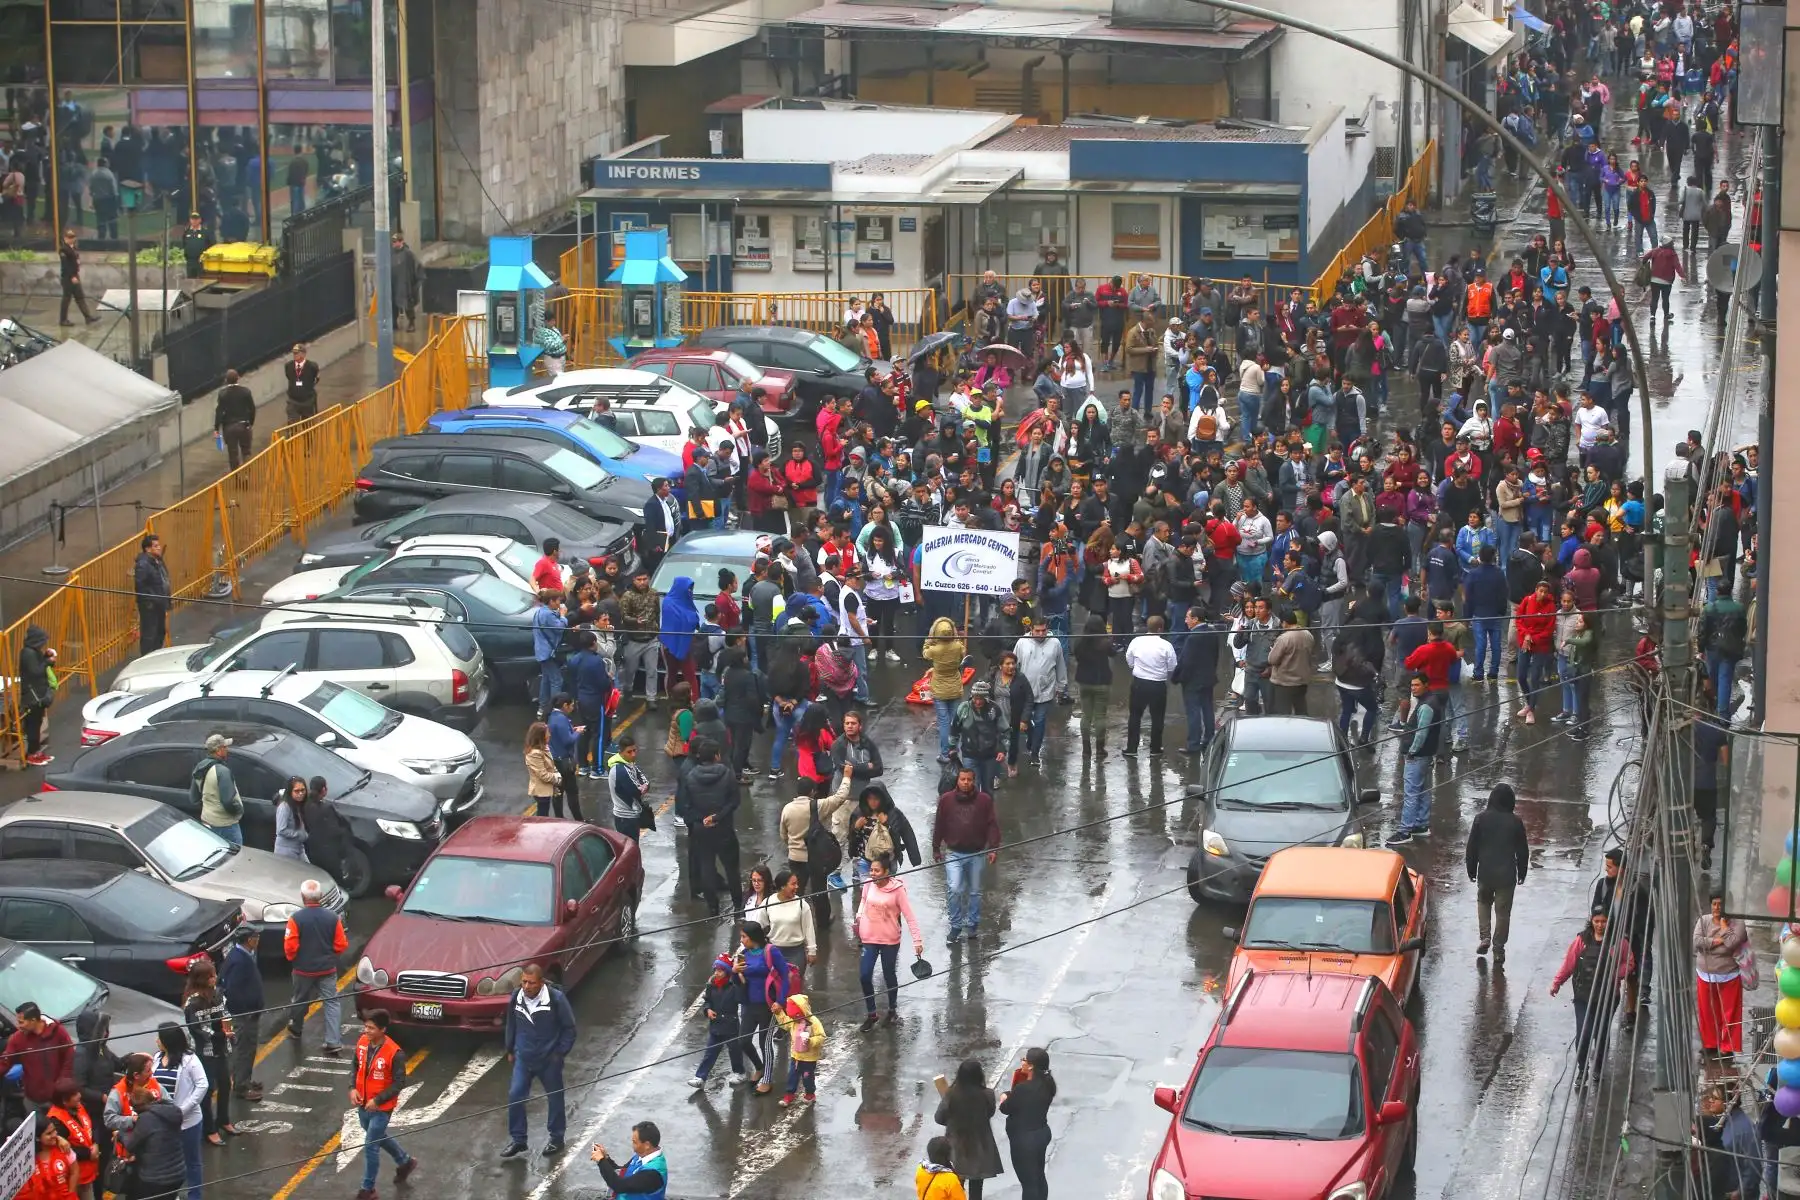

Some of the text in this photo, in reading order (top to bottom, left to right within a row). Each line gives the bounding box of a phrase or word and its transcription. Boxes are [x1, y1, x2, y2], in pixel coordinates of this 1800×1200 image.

[608, 165, 701, 180] INFORMES
[924, 533, 1016, 560] GALERIA MERCADO CENTRAL
[934, 581, 956, 589] Cuzco
[957, 582, 970, 590] 626
[994, 585, 1011, 593] Lima
